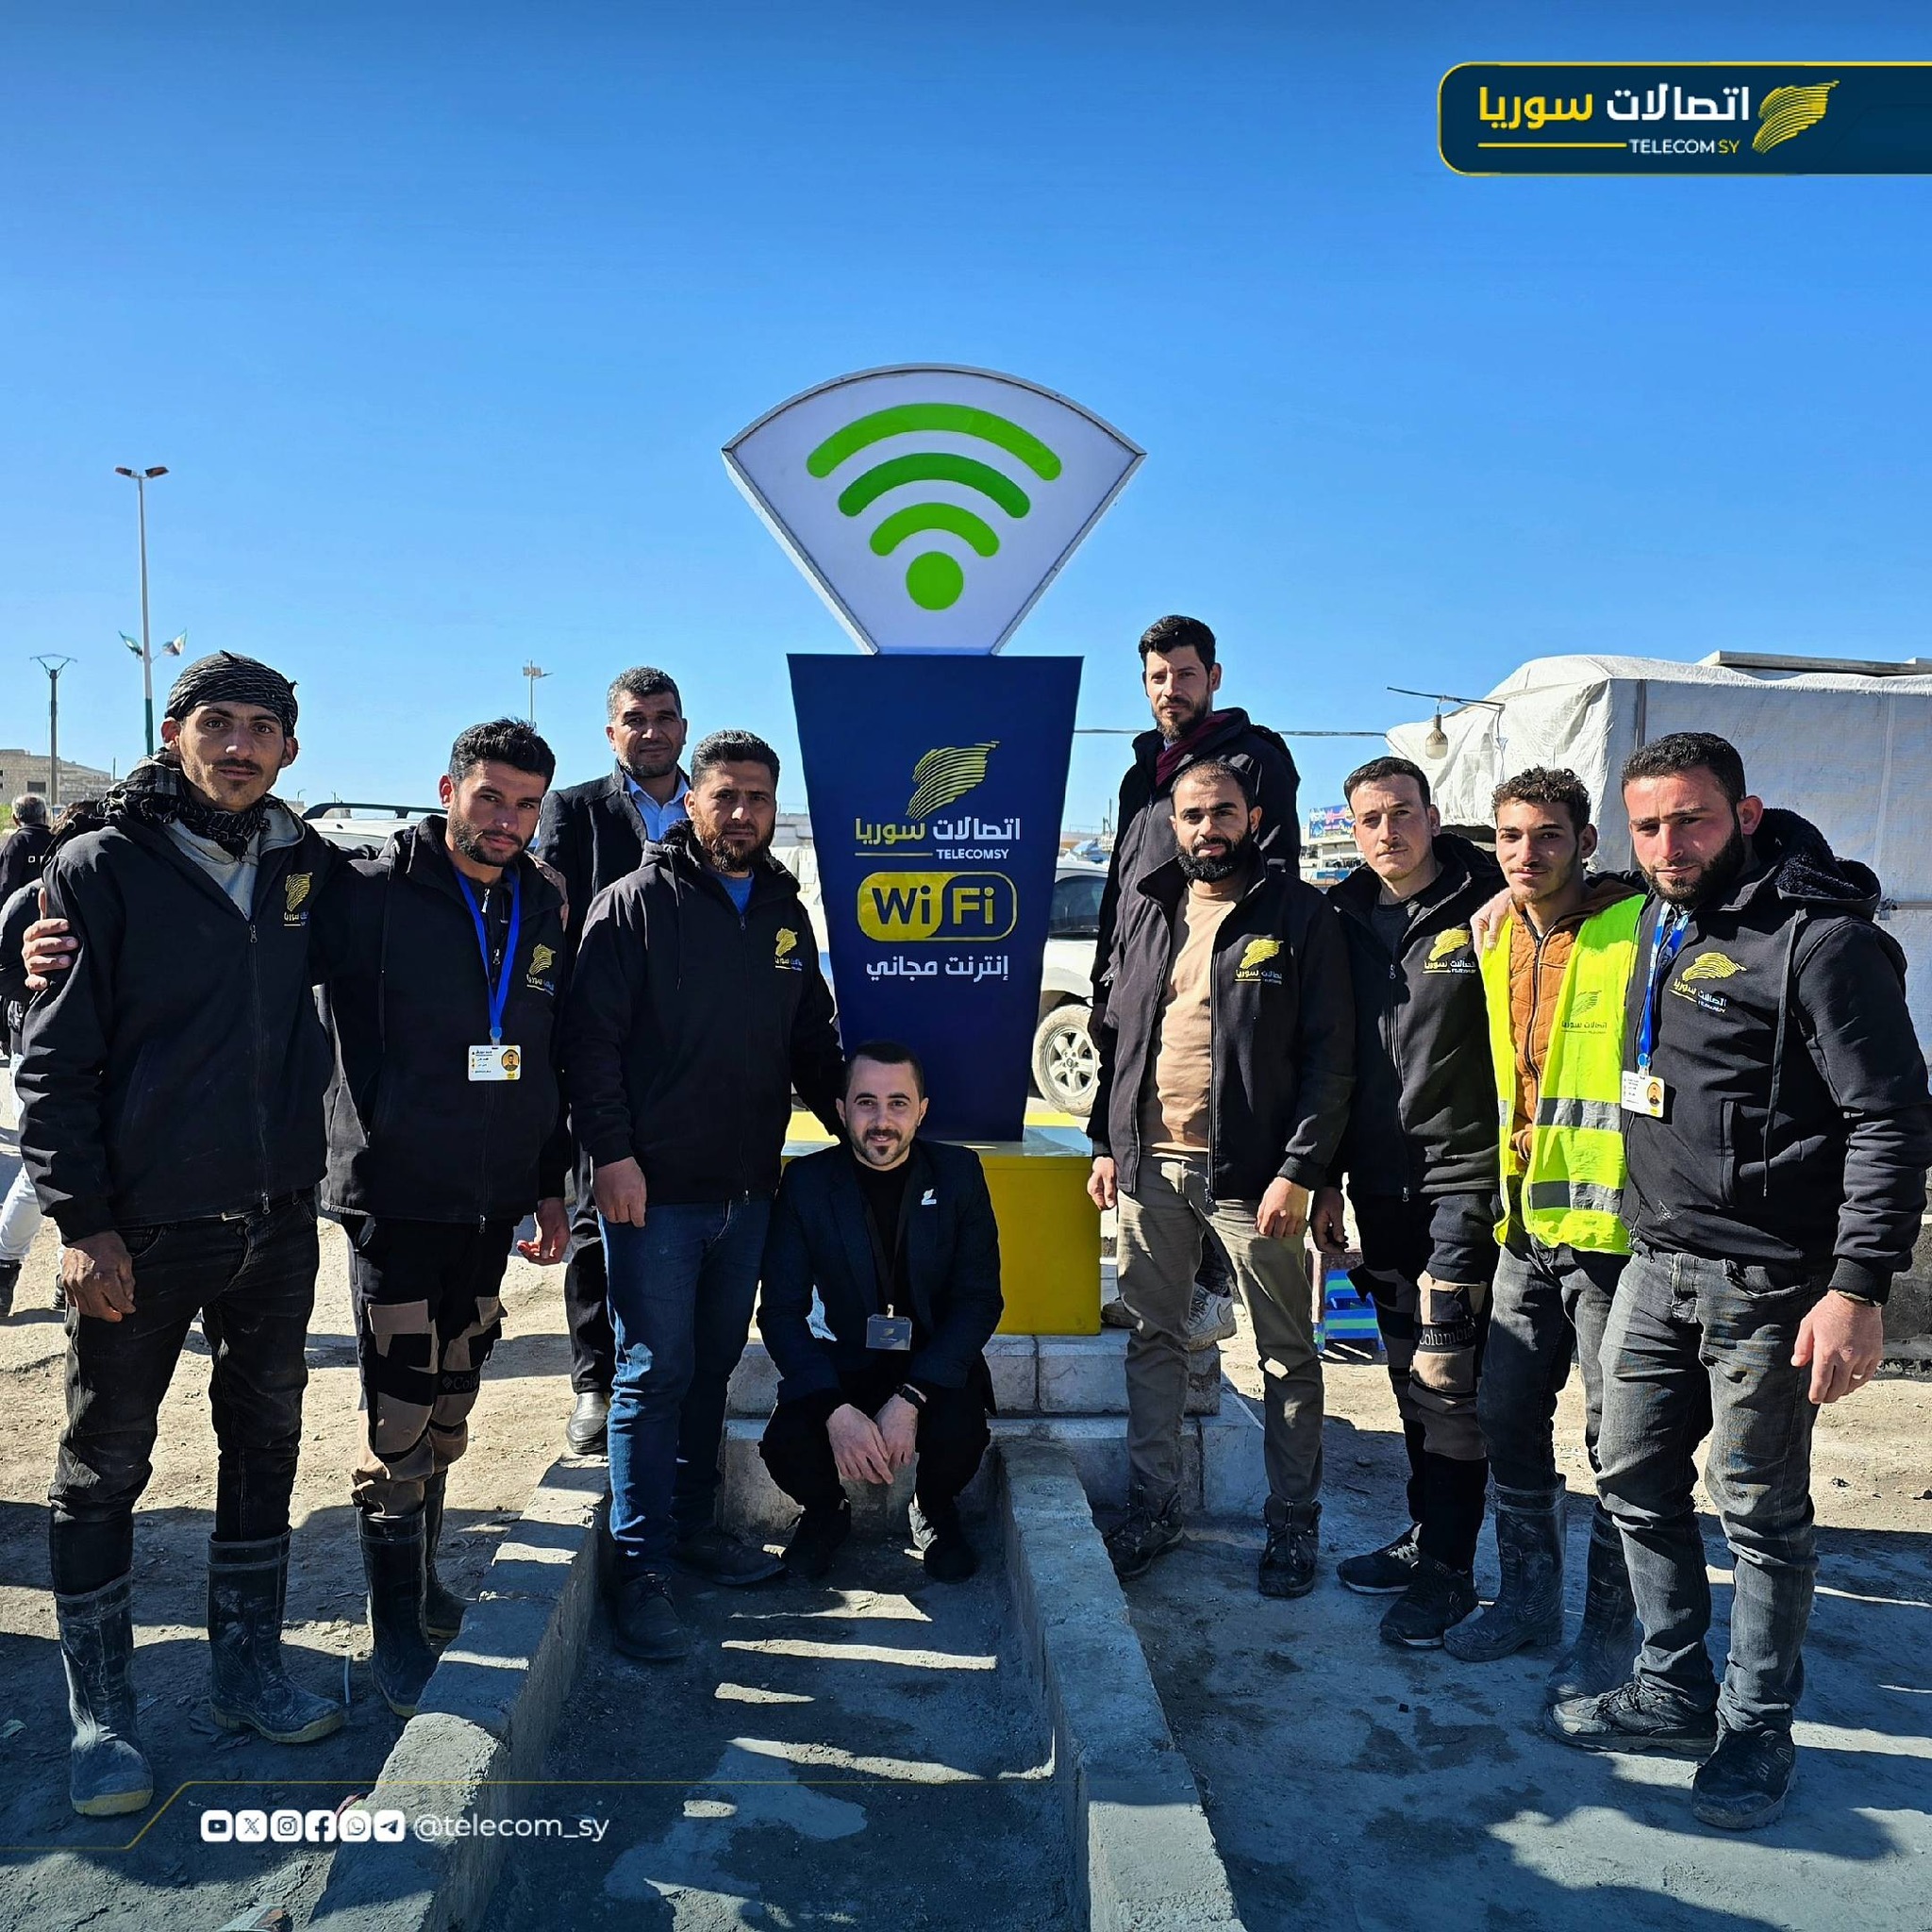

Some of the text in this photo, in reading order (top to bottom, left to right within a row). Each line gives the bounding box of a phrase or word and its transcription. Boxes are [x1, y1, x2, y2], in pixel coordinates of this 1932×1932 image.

[855, 816, 1021, 845] اتصالات سوريا
[936, 848, 1009, 860] TELECOMSY
[866, 955, 1009, 983] إنترنت مجاني
